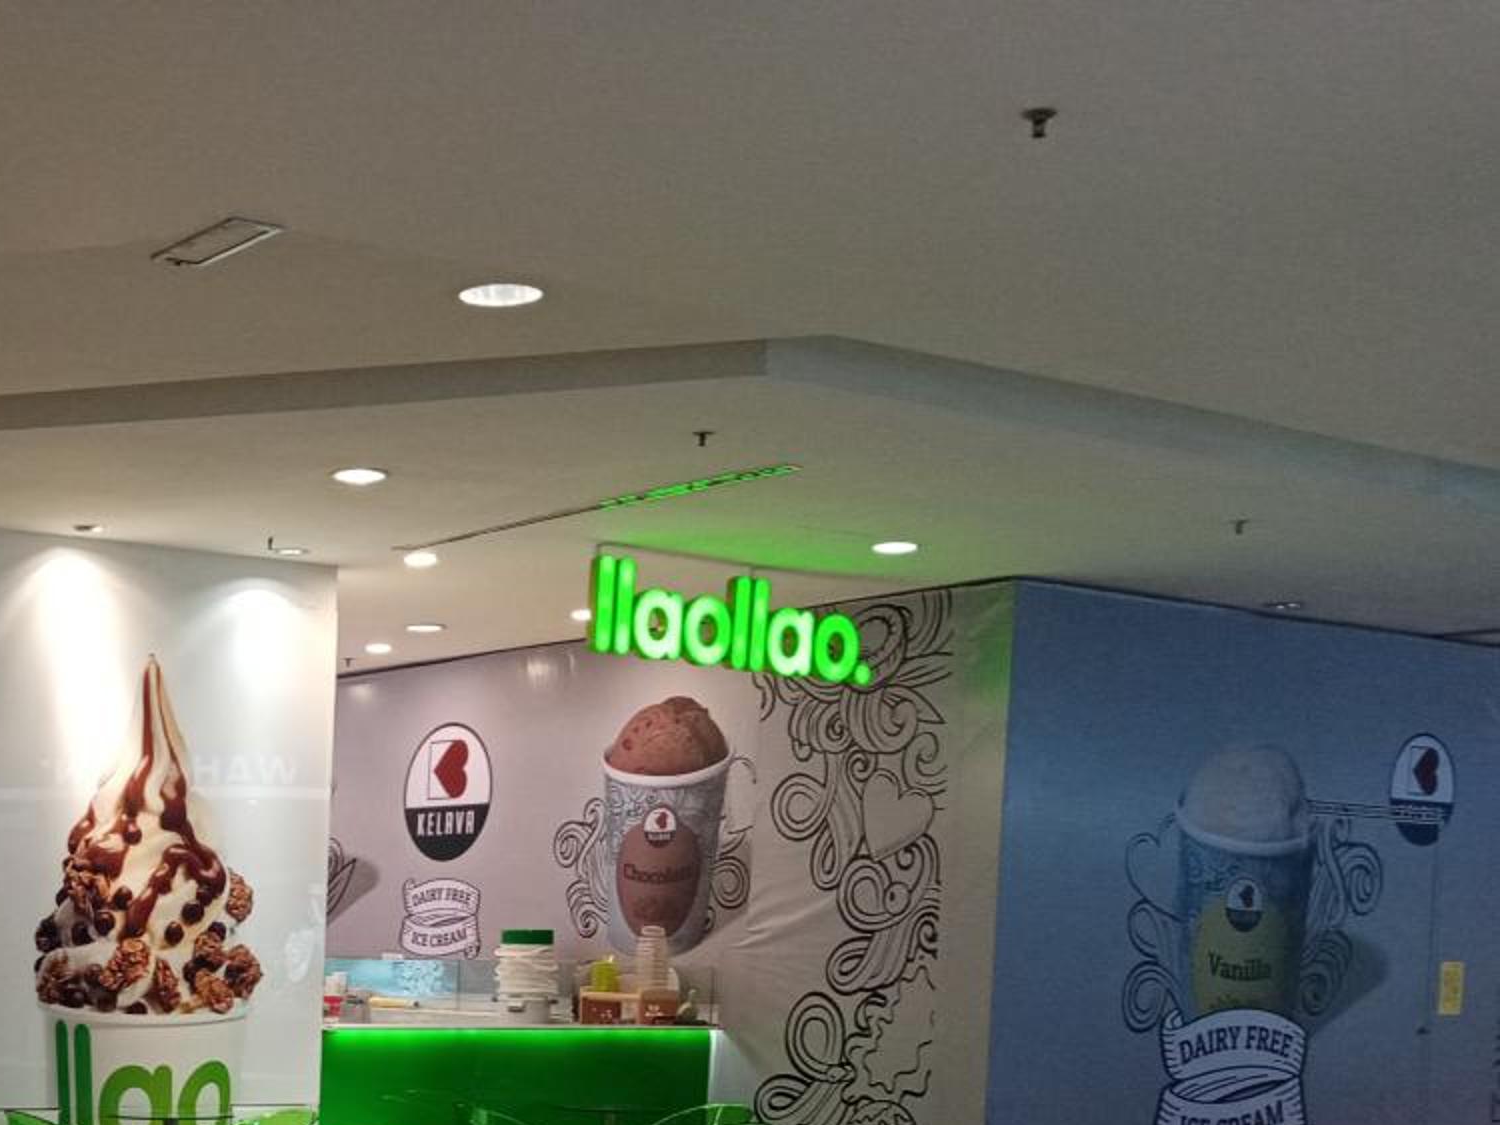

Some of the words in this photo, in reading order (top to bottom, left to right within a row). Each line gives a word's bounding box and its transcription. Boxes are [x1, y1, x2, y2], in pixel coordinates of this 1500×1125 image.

[417, 810, 476, 837] KELAVA
[411, 931, 429, 948] ICE
[429, 927, 467, 948] CREAM
[1208, 951, 1272, 981] Vanilla
[1179, 1025, 1241, 1065] DAIRY
[1244, 1025, 1294, 1059] FREE
